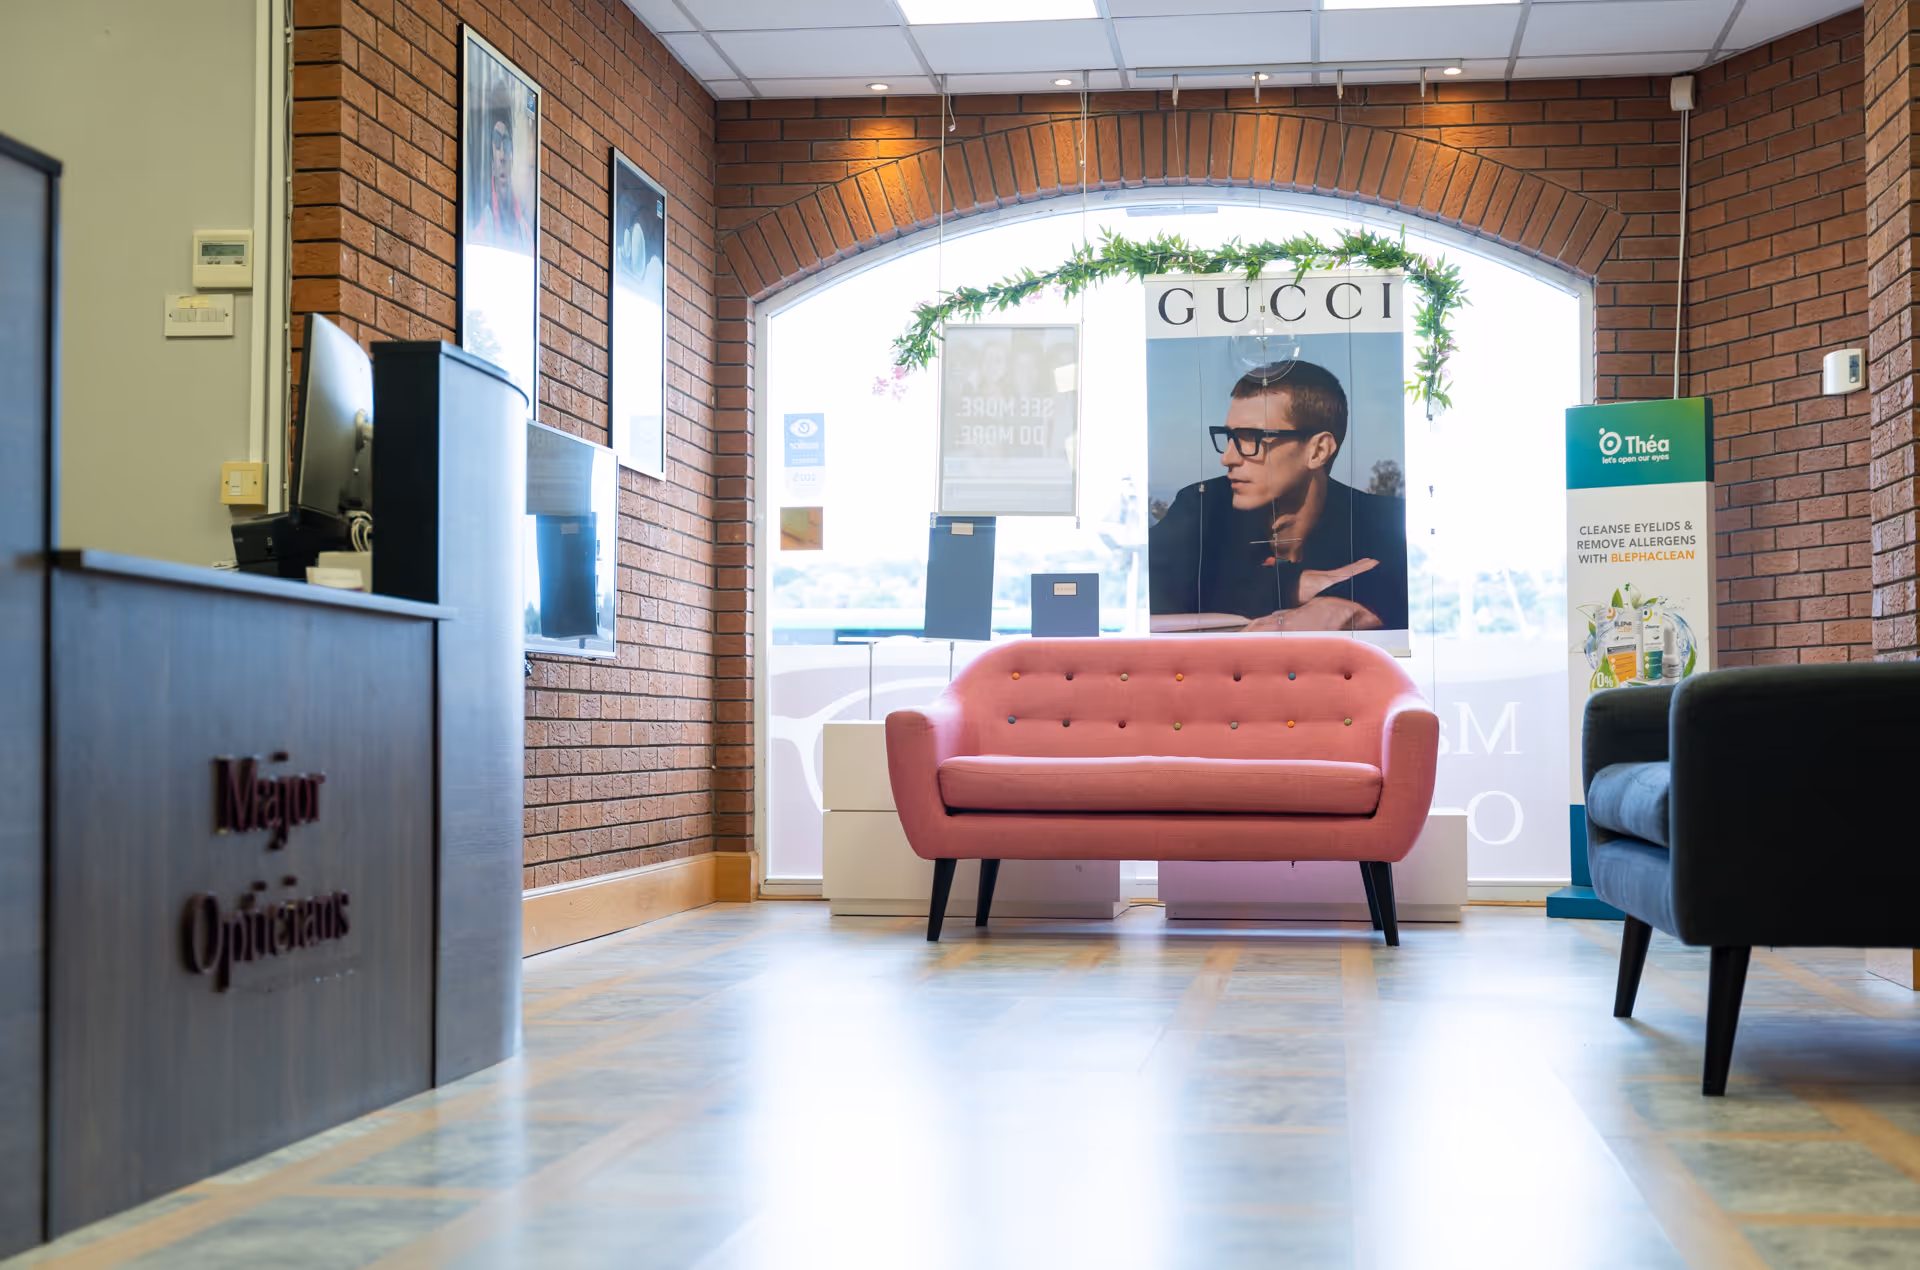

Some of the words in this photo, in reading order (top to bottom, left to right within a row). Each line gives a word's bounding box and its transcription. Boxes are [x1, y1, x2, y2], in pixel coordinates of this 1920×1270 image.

[1157, 282, 1392, 325] GUCCI
[1624, 434, 1670, 454] Théa
[1602, 456, 1617, 464] let's
[1618, 456, 1637, 464] open
[1651, 454, 1670, 462] eyes
[1579, 523, 1631, 536] CLEANSE
[1634, 521, 1681, 533] EYELIDS
[1683, 520, 1693, 531] &
[1576, 538, 1625, 550] REMOVE
[1628, 535, 1696, 548] ALLERGENS
[1578, 553, 1608, 564] WITH
[1611, 550, 1695, 563] BLEPHACLEAN
[1596, 672, 1614, 687] 0%
[211, 751, 326, 851] Major
[178, 875, 350, 992] Opticians
